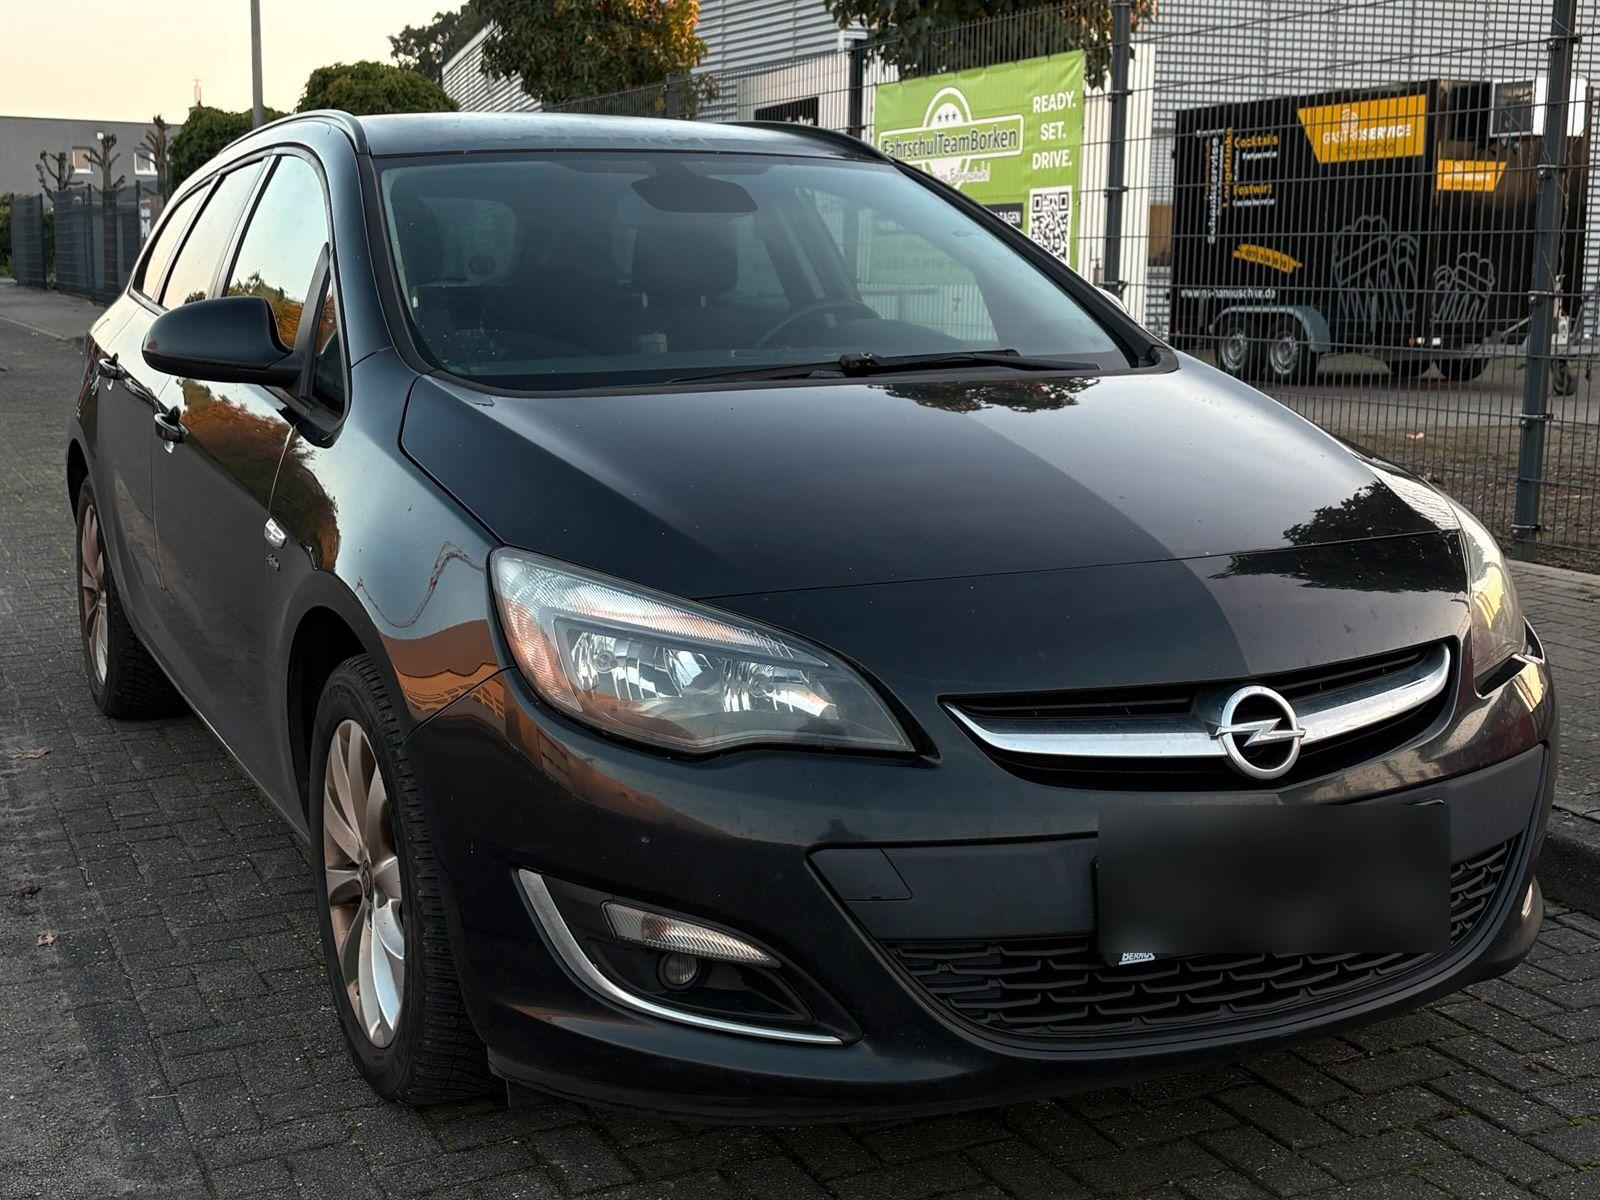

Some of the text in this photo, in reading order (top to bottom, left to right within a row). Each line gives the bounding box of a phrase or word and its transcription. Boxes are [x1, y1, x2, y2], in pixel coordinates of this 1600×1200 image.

[1033, 91, 1077, 113] READY.
[884, 124, 1017, 158] FahrschulTeamBorken
[1040, 121, 1067, 140] SET.
[1032, 149, 1073, 170] DRIVE.
